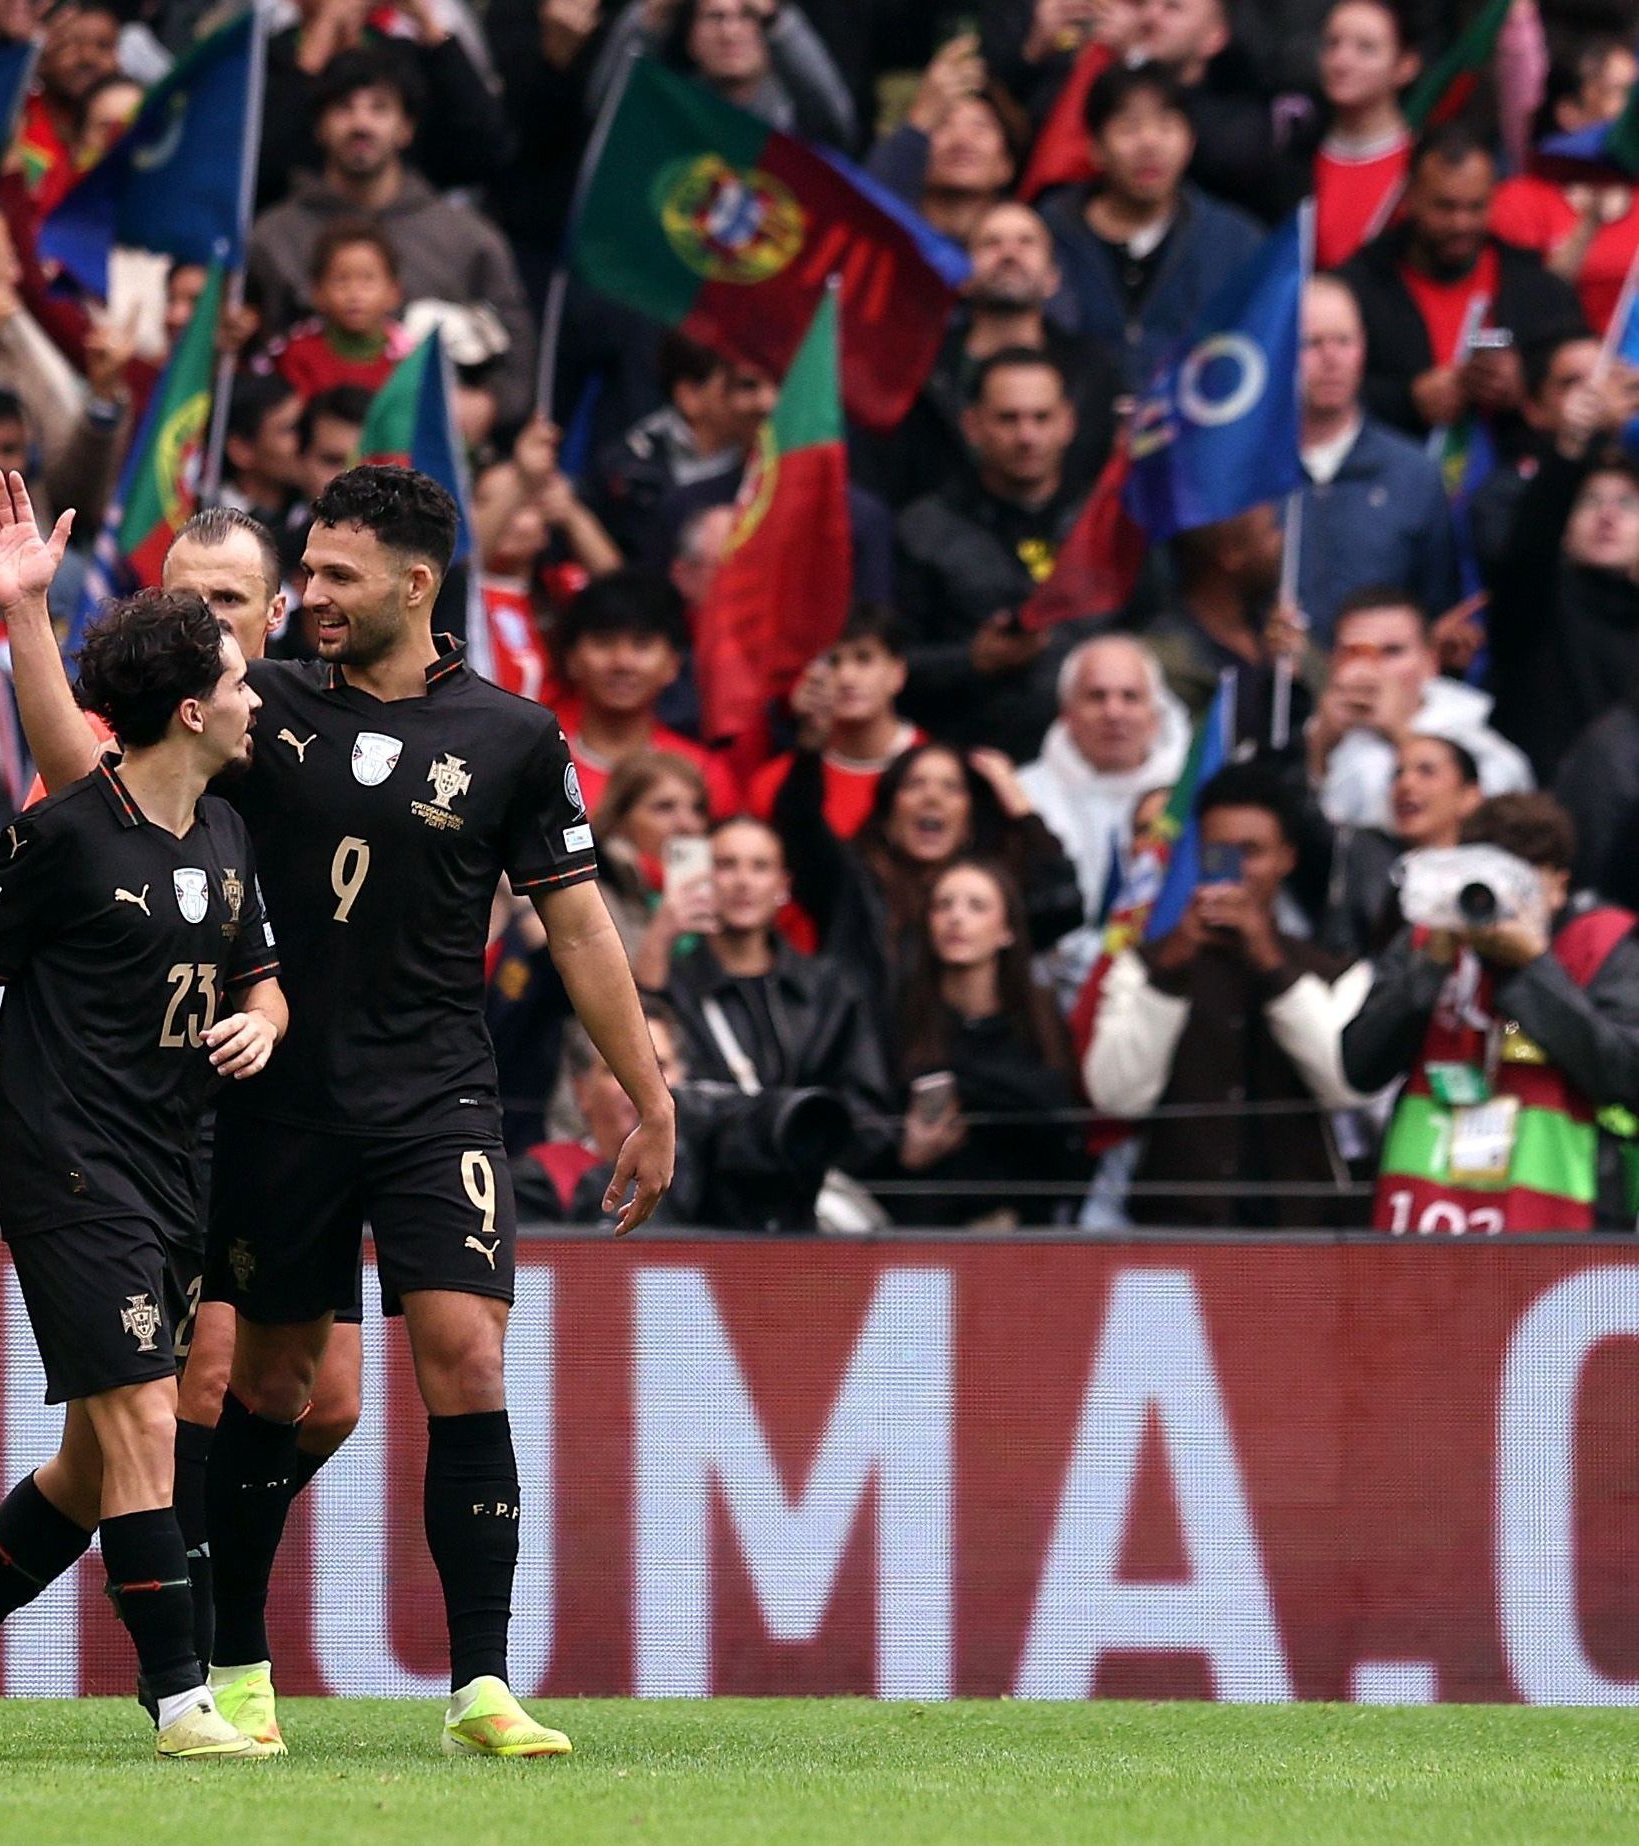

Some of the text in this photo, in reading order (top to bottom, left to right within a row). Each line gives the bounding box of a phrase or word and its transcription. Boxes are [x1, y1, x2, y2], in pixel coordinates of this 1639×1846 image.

[331, 836, 370, 923] 9
[159, 963, 217, 1048] 23
[461, 1151, 496, 1232] 9
